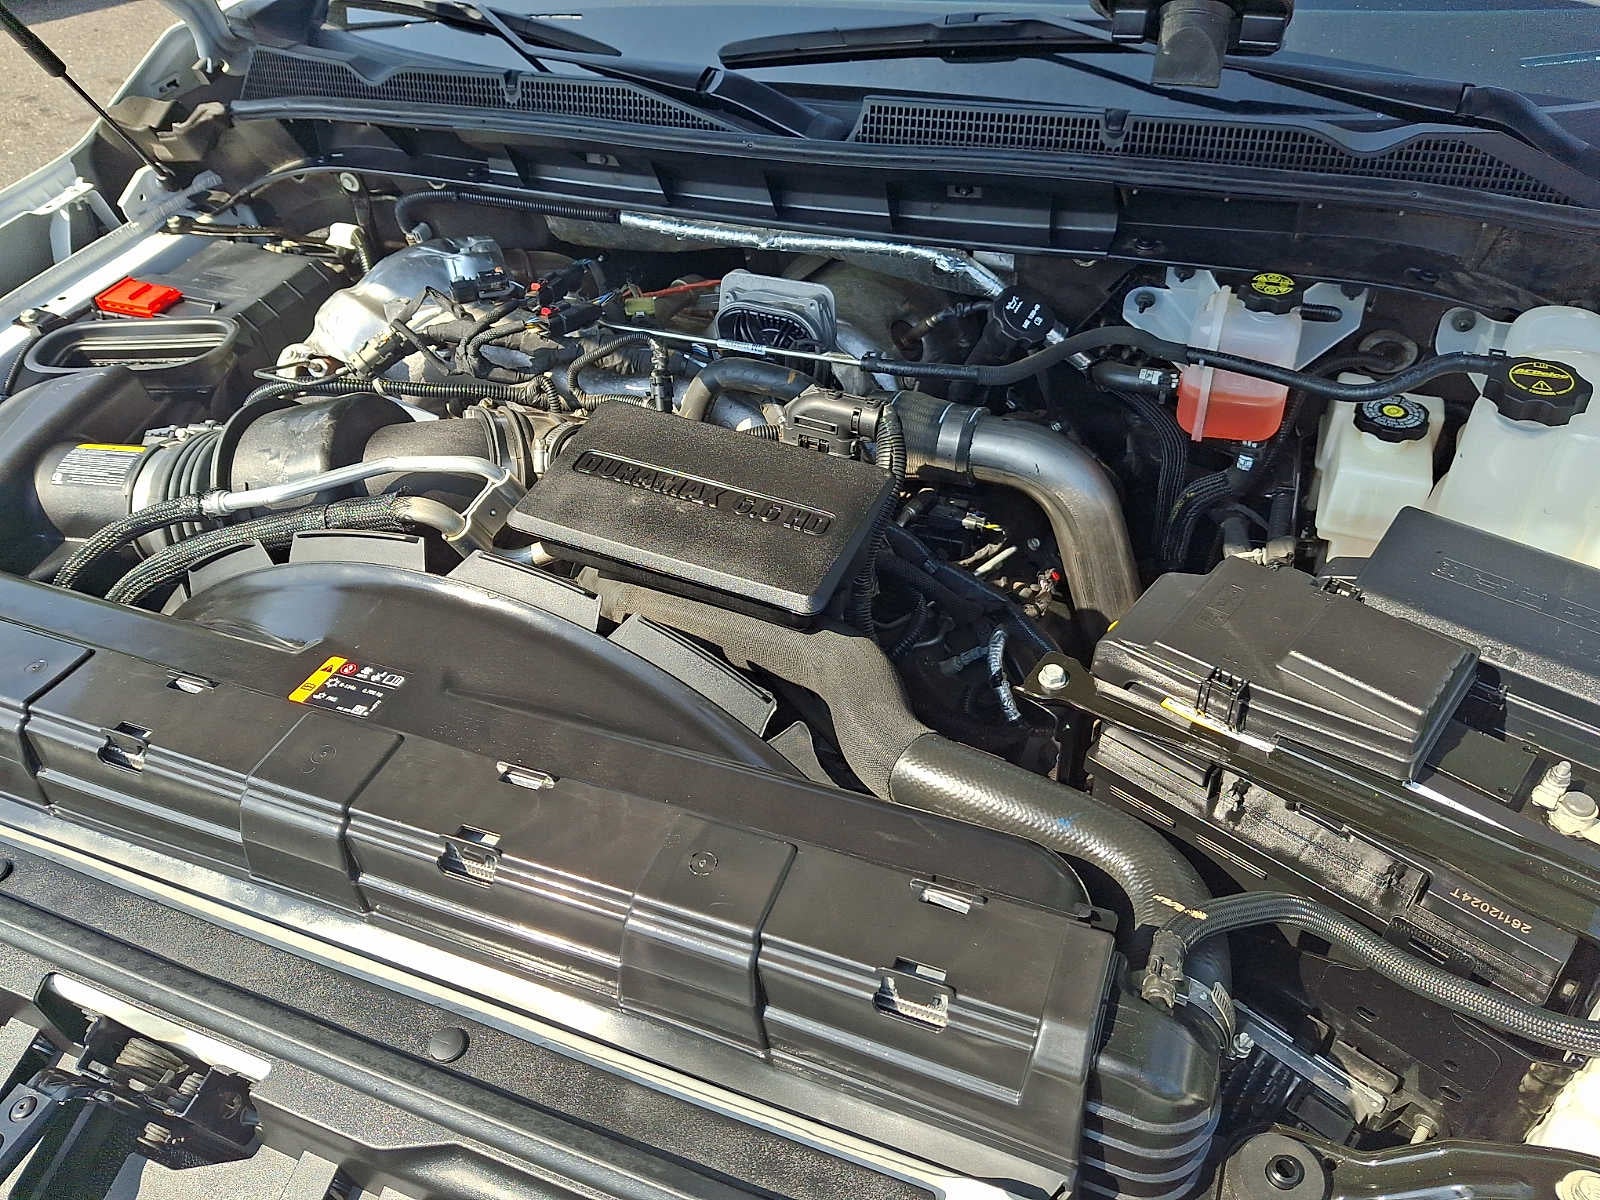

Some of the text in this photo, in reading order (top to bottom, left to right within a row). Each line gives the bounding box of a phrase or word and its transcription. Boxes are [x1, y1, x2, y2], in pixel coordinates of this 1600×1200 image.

[576, 455, 832, 536] DURAMAX 6.6 HD
[1449, 888, 1533, 934] 26112024T
